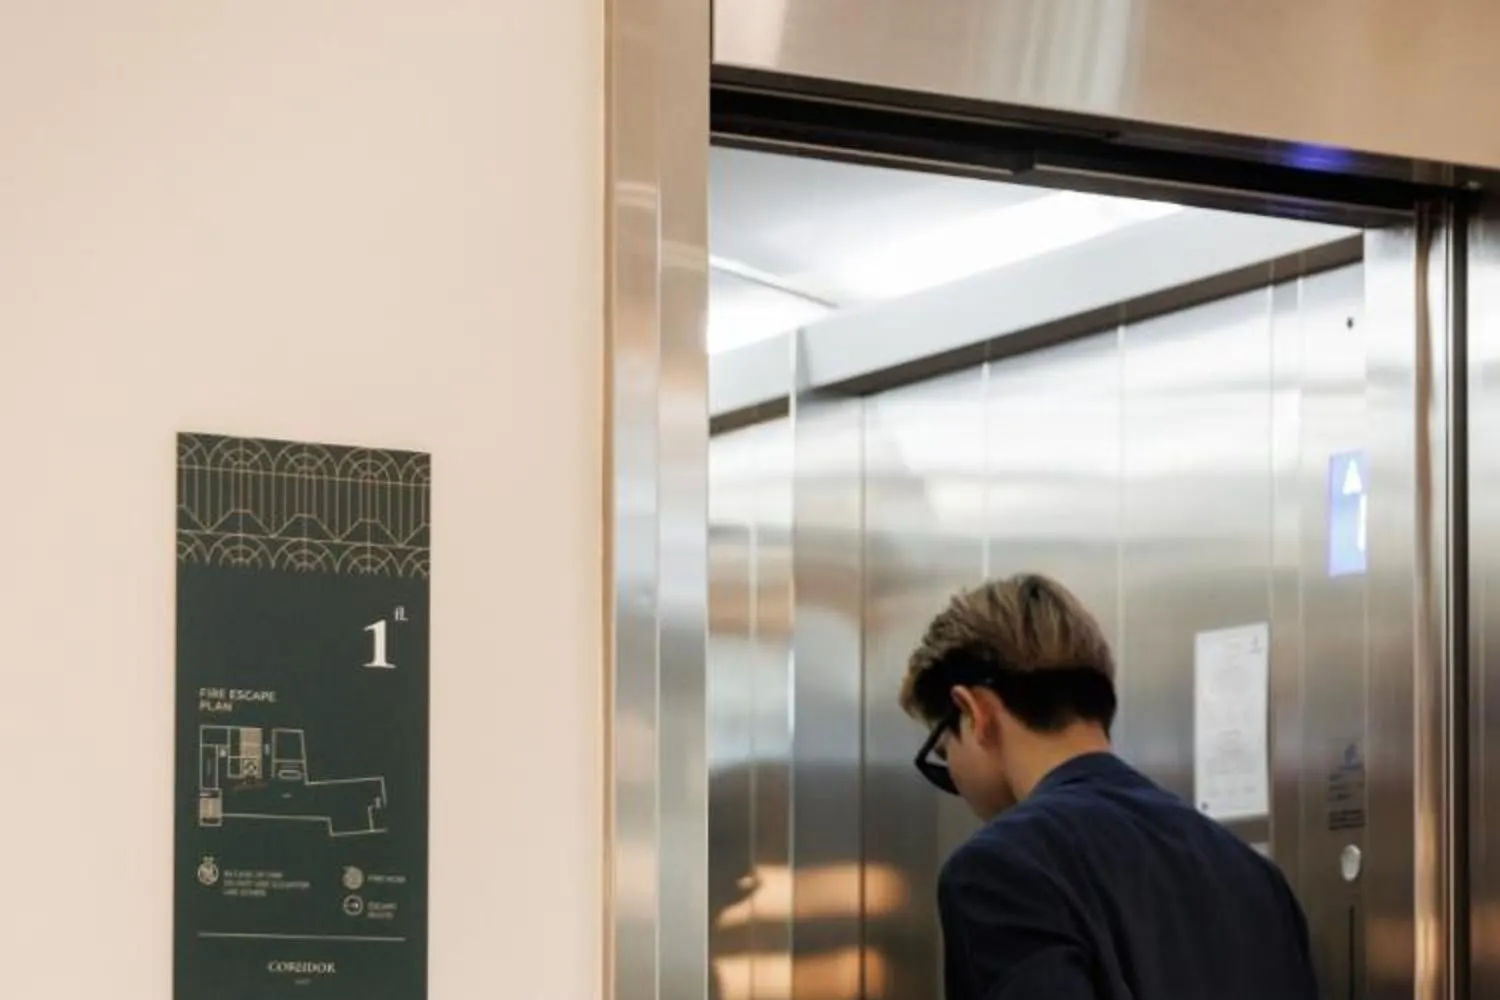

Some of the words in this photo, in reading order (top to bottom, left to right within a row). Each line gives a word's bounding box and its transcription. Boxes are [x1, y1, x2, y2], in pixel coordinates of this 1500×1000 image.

[361, 619, 397, 669] 1
[199, 687, 226, 700] FIRE
[229, 689, 277, 703] ESCAPE
[199, 700, 233, 712] PLAN
